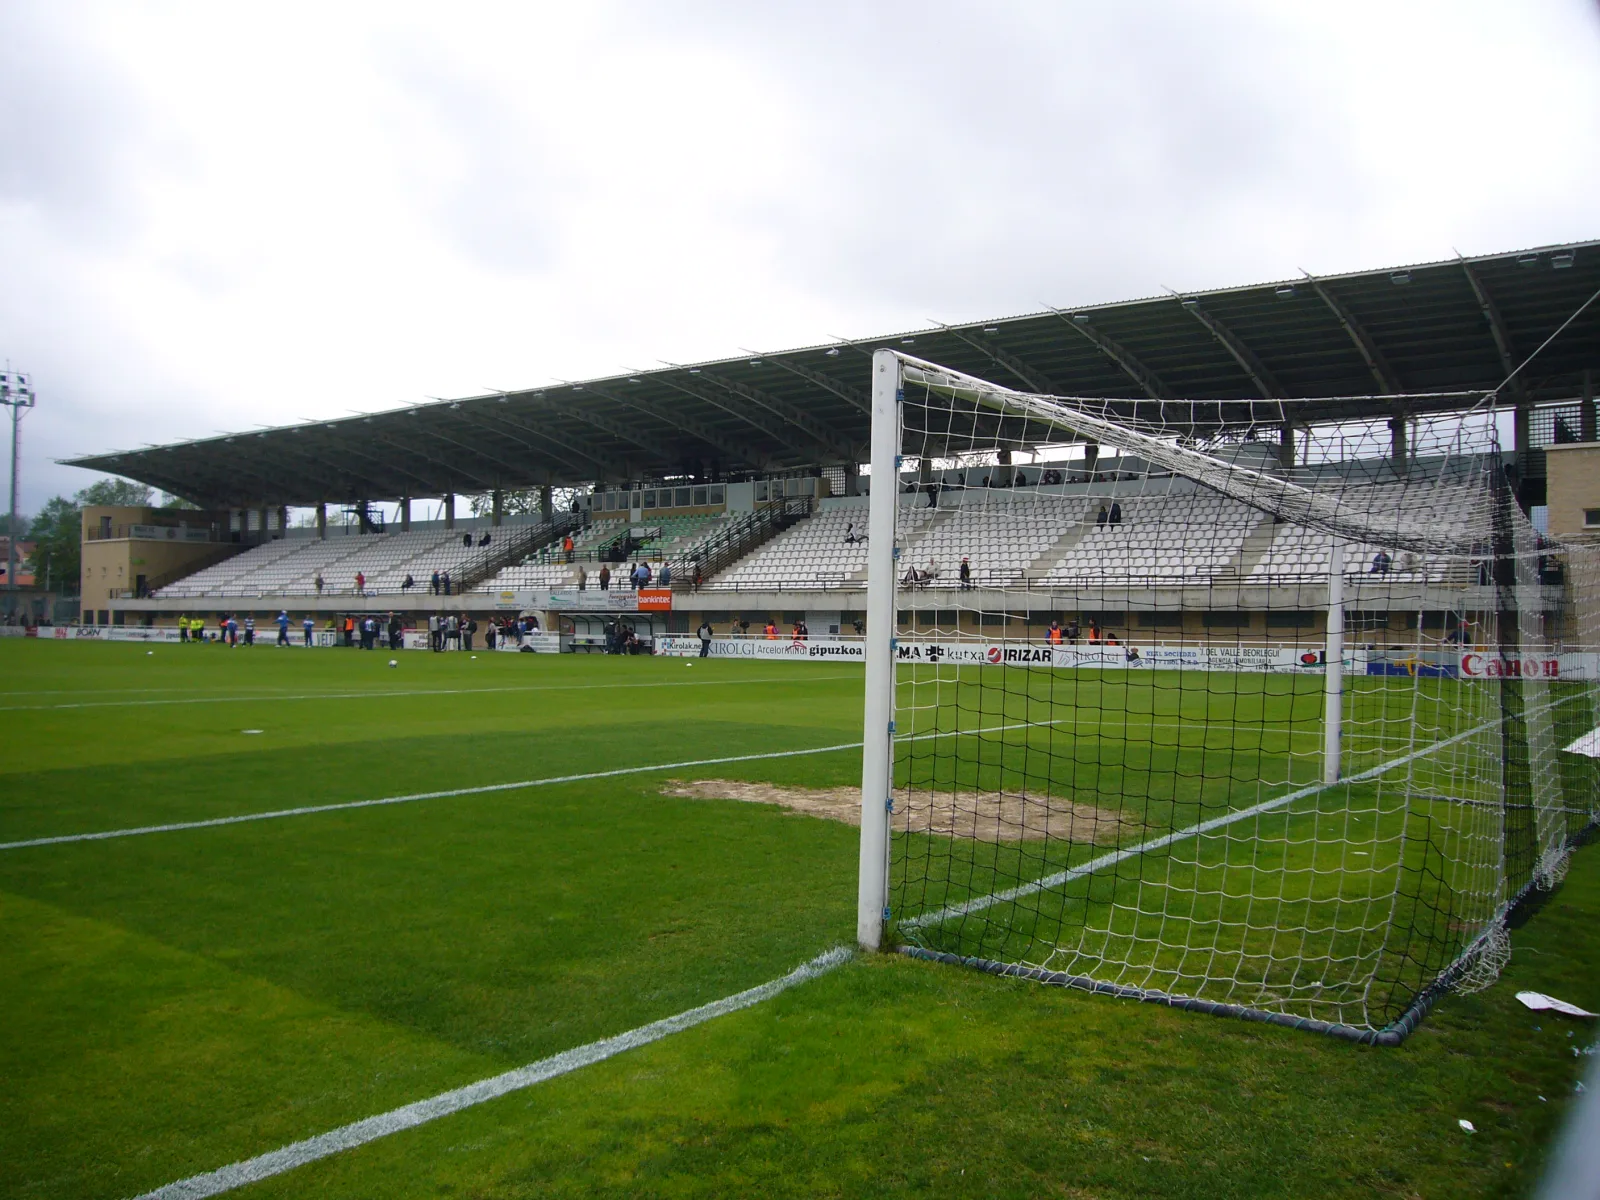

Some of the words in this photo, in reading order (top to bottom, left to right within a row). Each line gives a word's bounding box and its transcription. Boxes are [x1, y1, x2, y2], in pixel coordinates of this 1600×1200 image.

[708, 643, 755, 655] KIROLGI
[809, 645, 862, 656] gipuzkoa
[896, 646, 921, 659] MA
[948, 647, 985, 660] kutxa
[1220, 648, 1240, 656] VALLE
[1243, 649, 1279, 657] BEORLEGUI
[1004, 649, 1052, 662] IRIZAR
[1073, 652, 1119, 661] KIROGI
[1461, 654, 1559, 677] Canon
